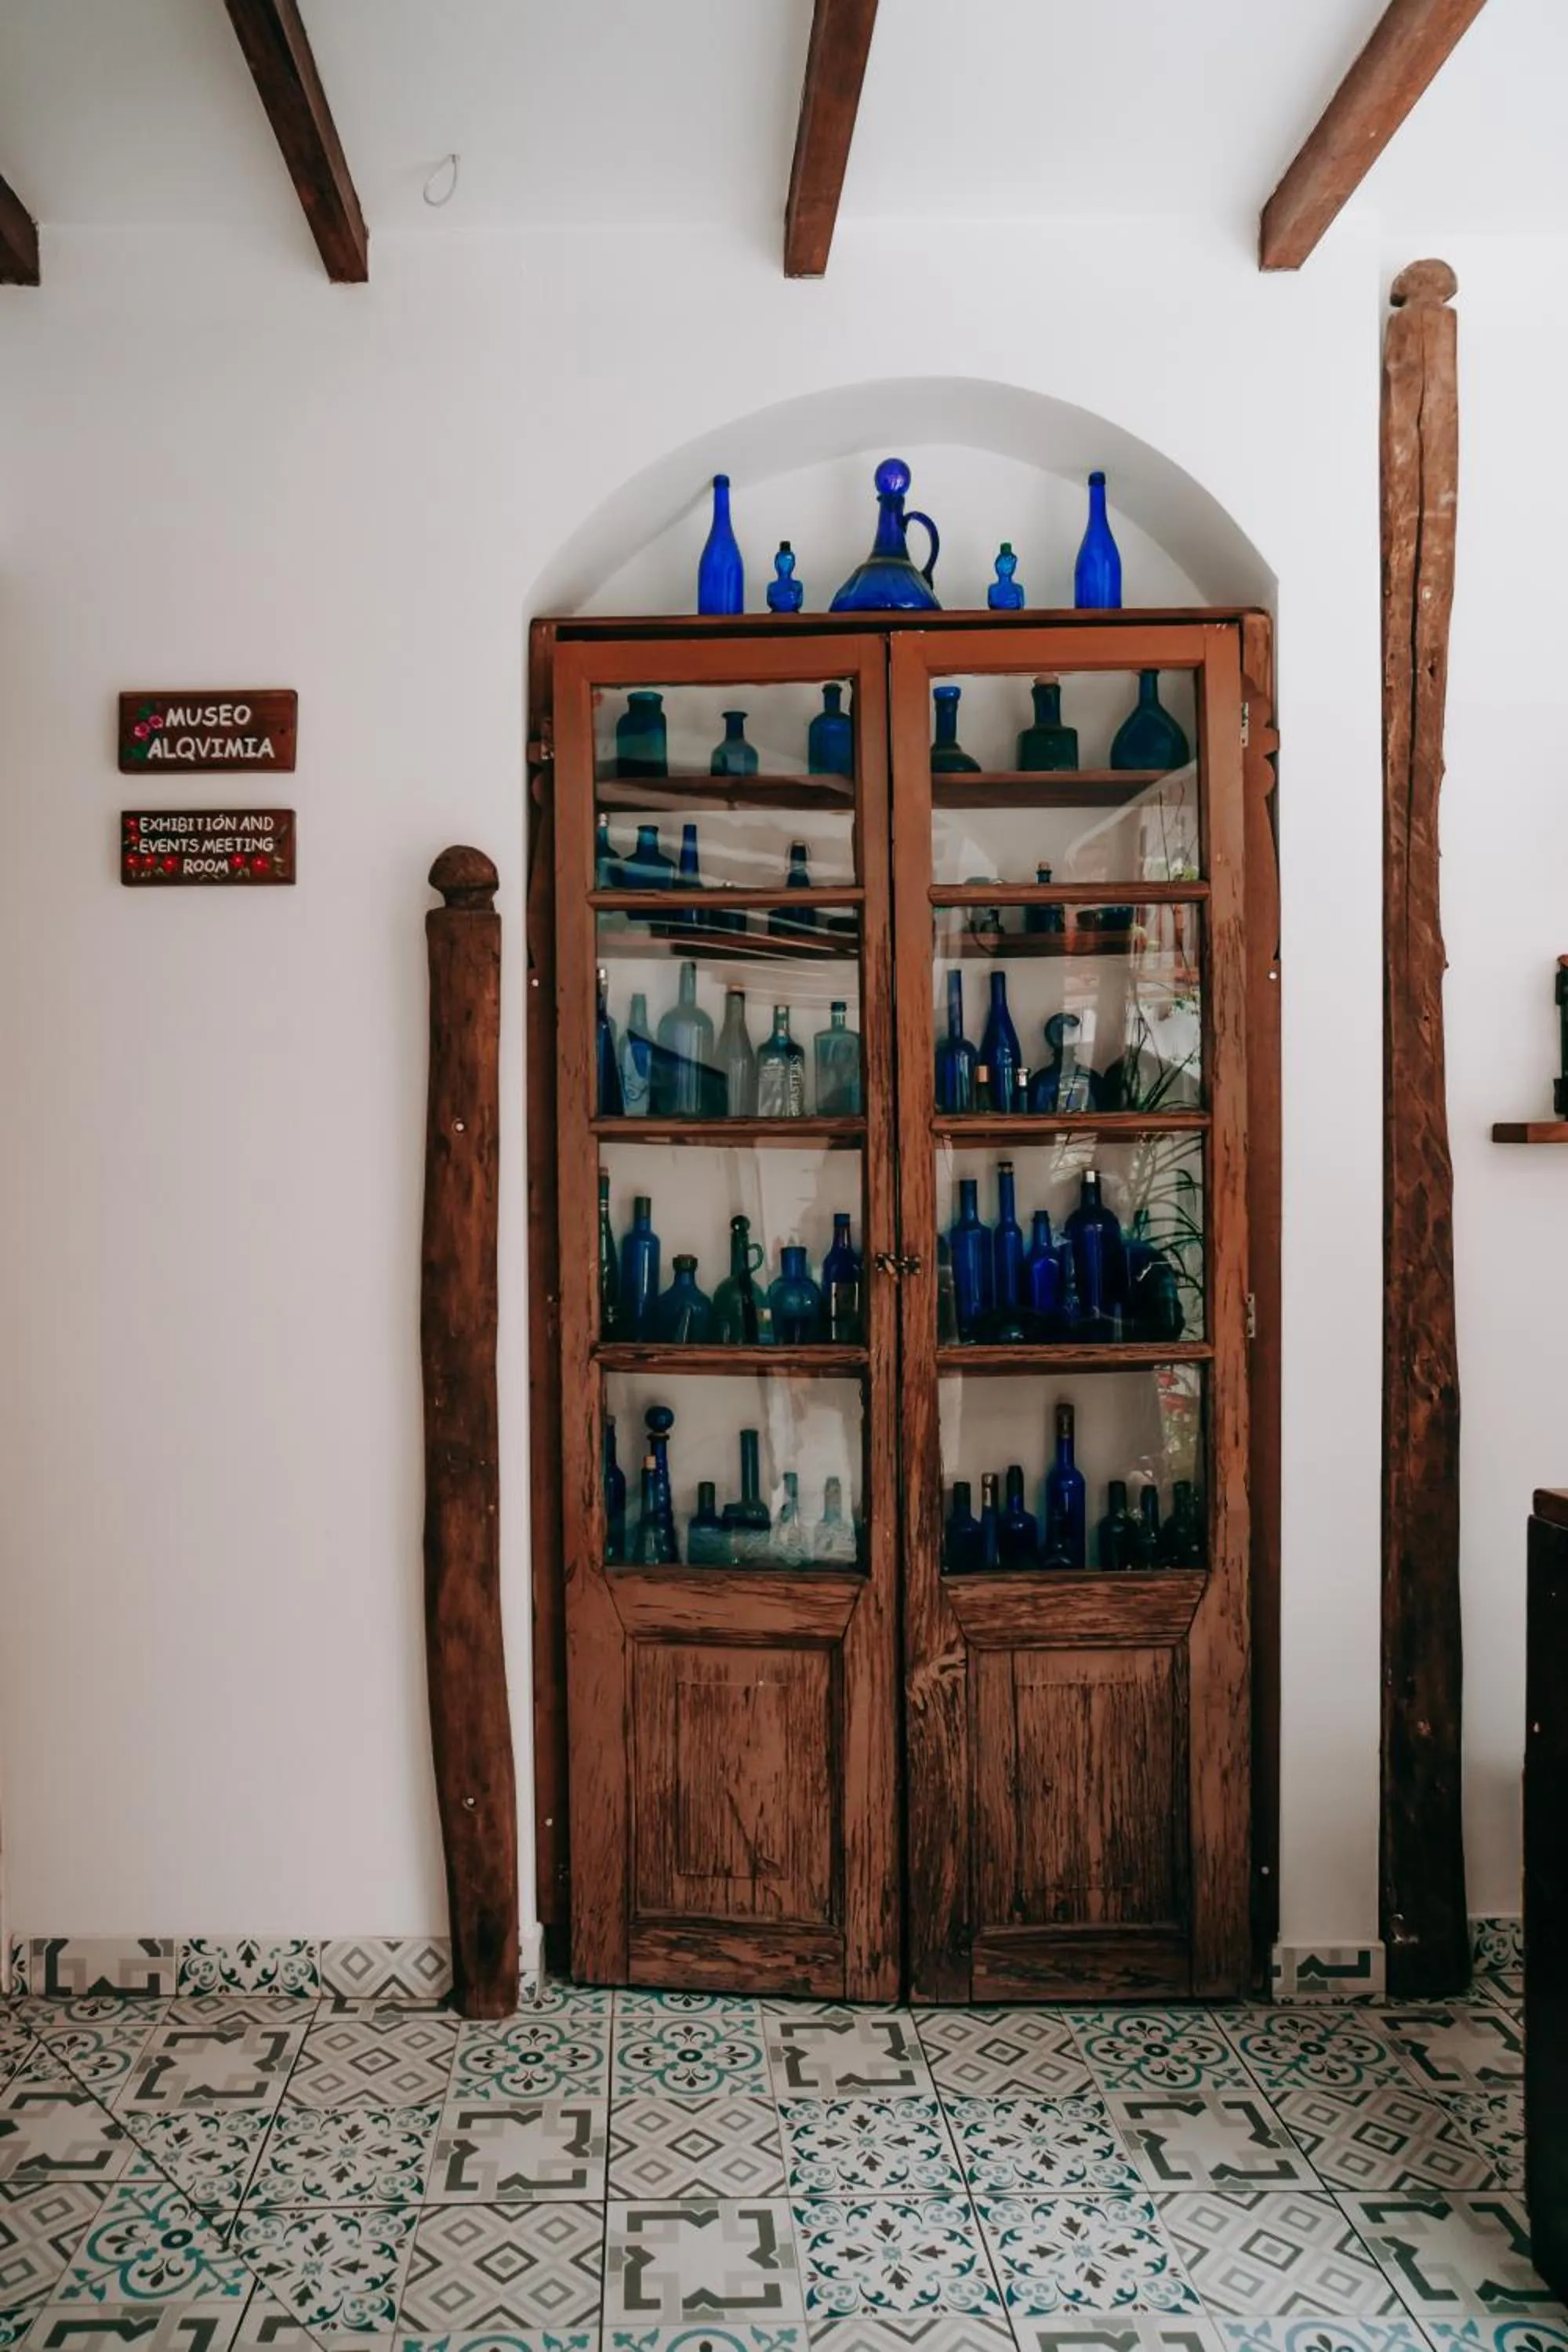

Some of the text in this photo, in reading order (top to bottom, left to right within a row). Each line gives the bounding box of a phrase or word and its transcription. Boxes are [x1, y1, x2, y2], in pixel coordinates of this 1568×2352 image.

[165, 704, 252, 728] MUSEO
[147, 736, 275, 762] ALQVIMIA
[240, 816, 274, 831] AND
[140, 837, 274, 854] EVENTS MEETING
[183, 858, 229, 874] ROOM
